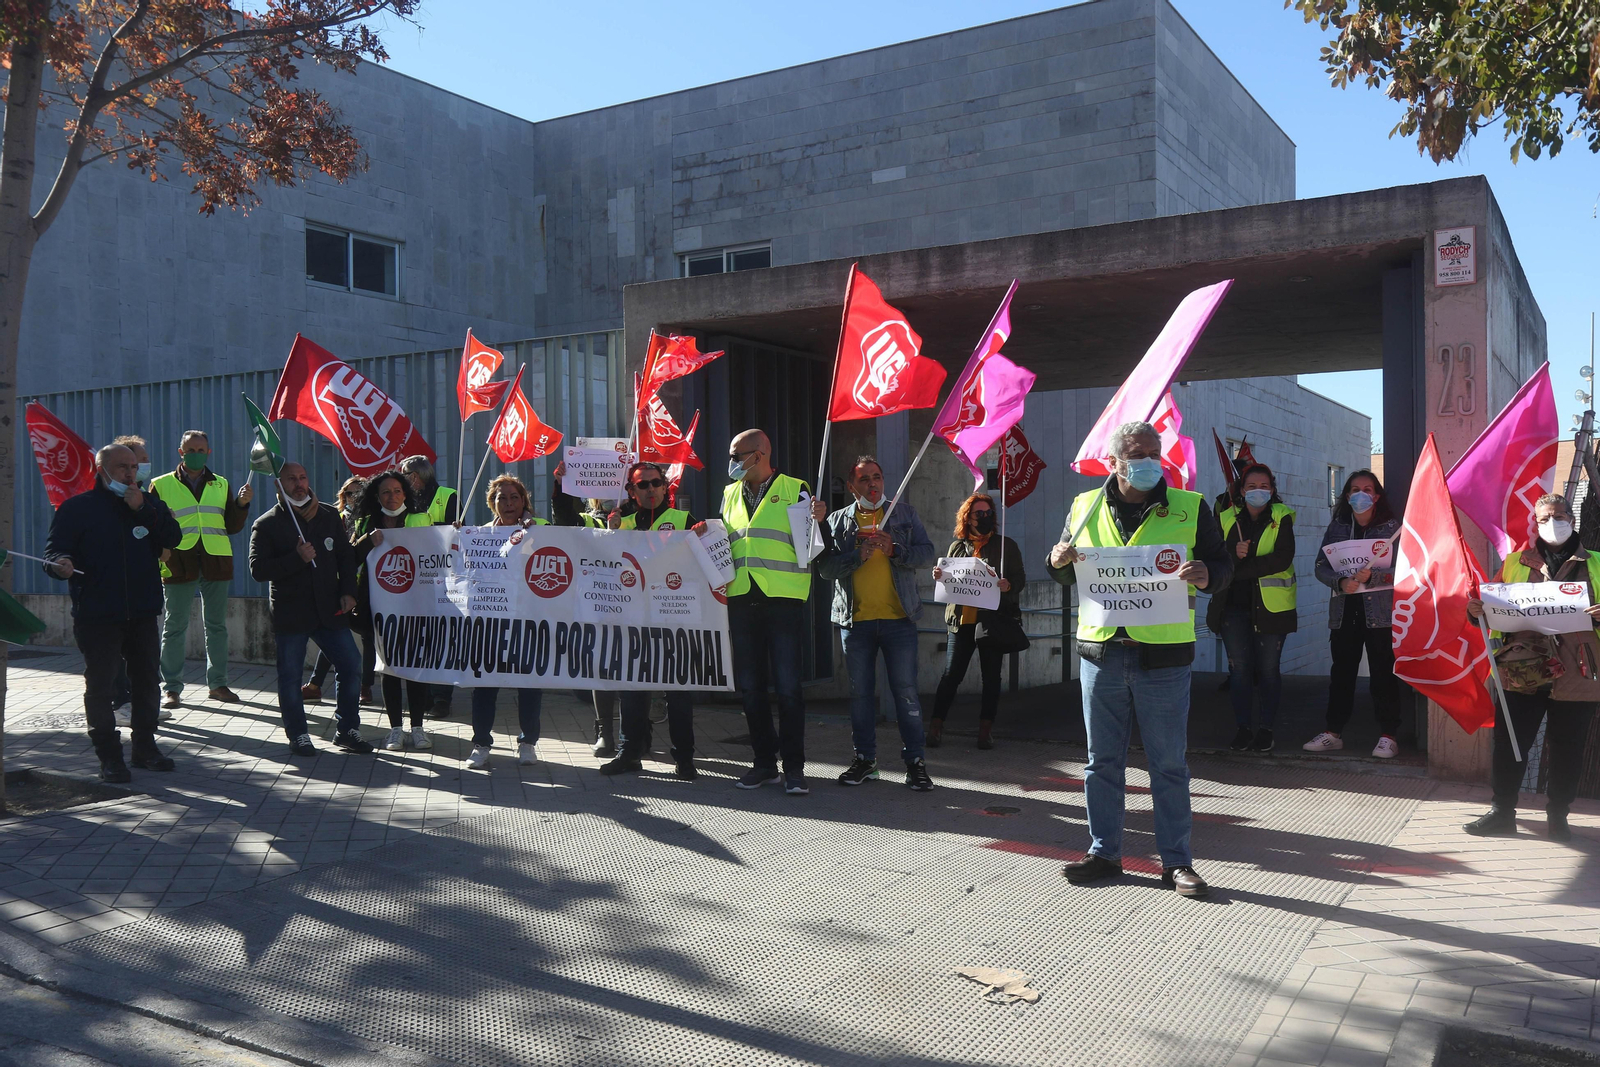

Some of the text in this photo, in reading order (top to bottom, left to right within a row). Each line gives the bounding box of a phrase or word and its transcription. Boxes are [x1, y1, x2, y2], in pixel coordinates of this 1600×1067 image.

[1440, 245, 1469, 256] RODYCH
[1440, 253, 1469, 261] SEGURIDAD
[1437, 342, 1476, 416] 23
[329, 365, 406, 441] UGT
[582, 462, 626, 470] QUEREMO
[470, 537, 508, 547] SECTOR
[465, 549, 509, 558] LIMPIEZA
[1159, 552, 1178, 562] UGT
[380, 553, 412, 573] UGT
[418, 554, 453, 569] FeSMC
[464, 561, 508, 570] GRANADA
[533, 555, 568, 574] UGT
[1340, 556, 1370, 566] SOMOS
[953, 568, 987, 578] POR UN
[1096, 566, 1154, 578] POR UN
[593, 581, 622, 592] POR UN
[944, 577, 993, 589] CONVENIO
[1089, 581, 1168, 594] CONVENIO
[584, 592, 632, 603] CONVENIO
[953, 587, 981, 597] DIGNO
[1103, 598, 1153, 611] DIGNO
[1507, 596, 1556, 606] SOMOS
[472, 604, 508, 612] GRANADA
[594, 604, 623, 614] DIGNO
[1491, 604, 1577, 618] ESENCIALES
[374, 612, 728, 687] CONVENIO BLOQUEADO POR LA PATRONAL
